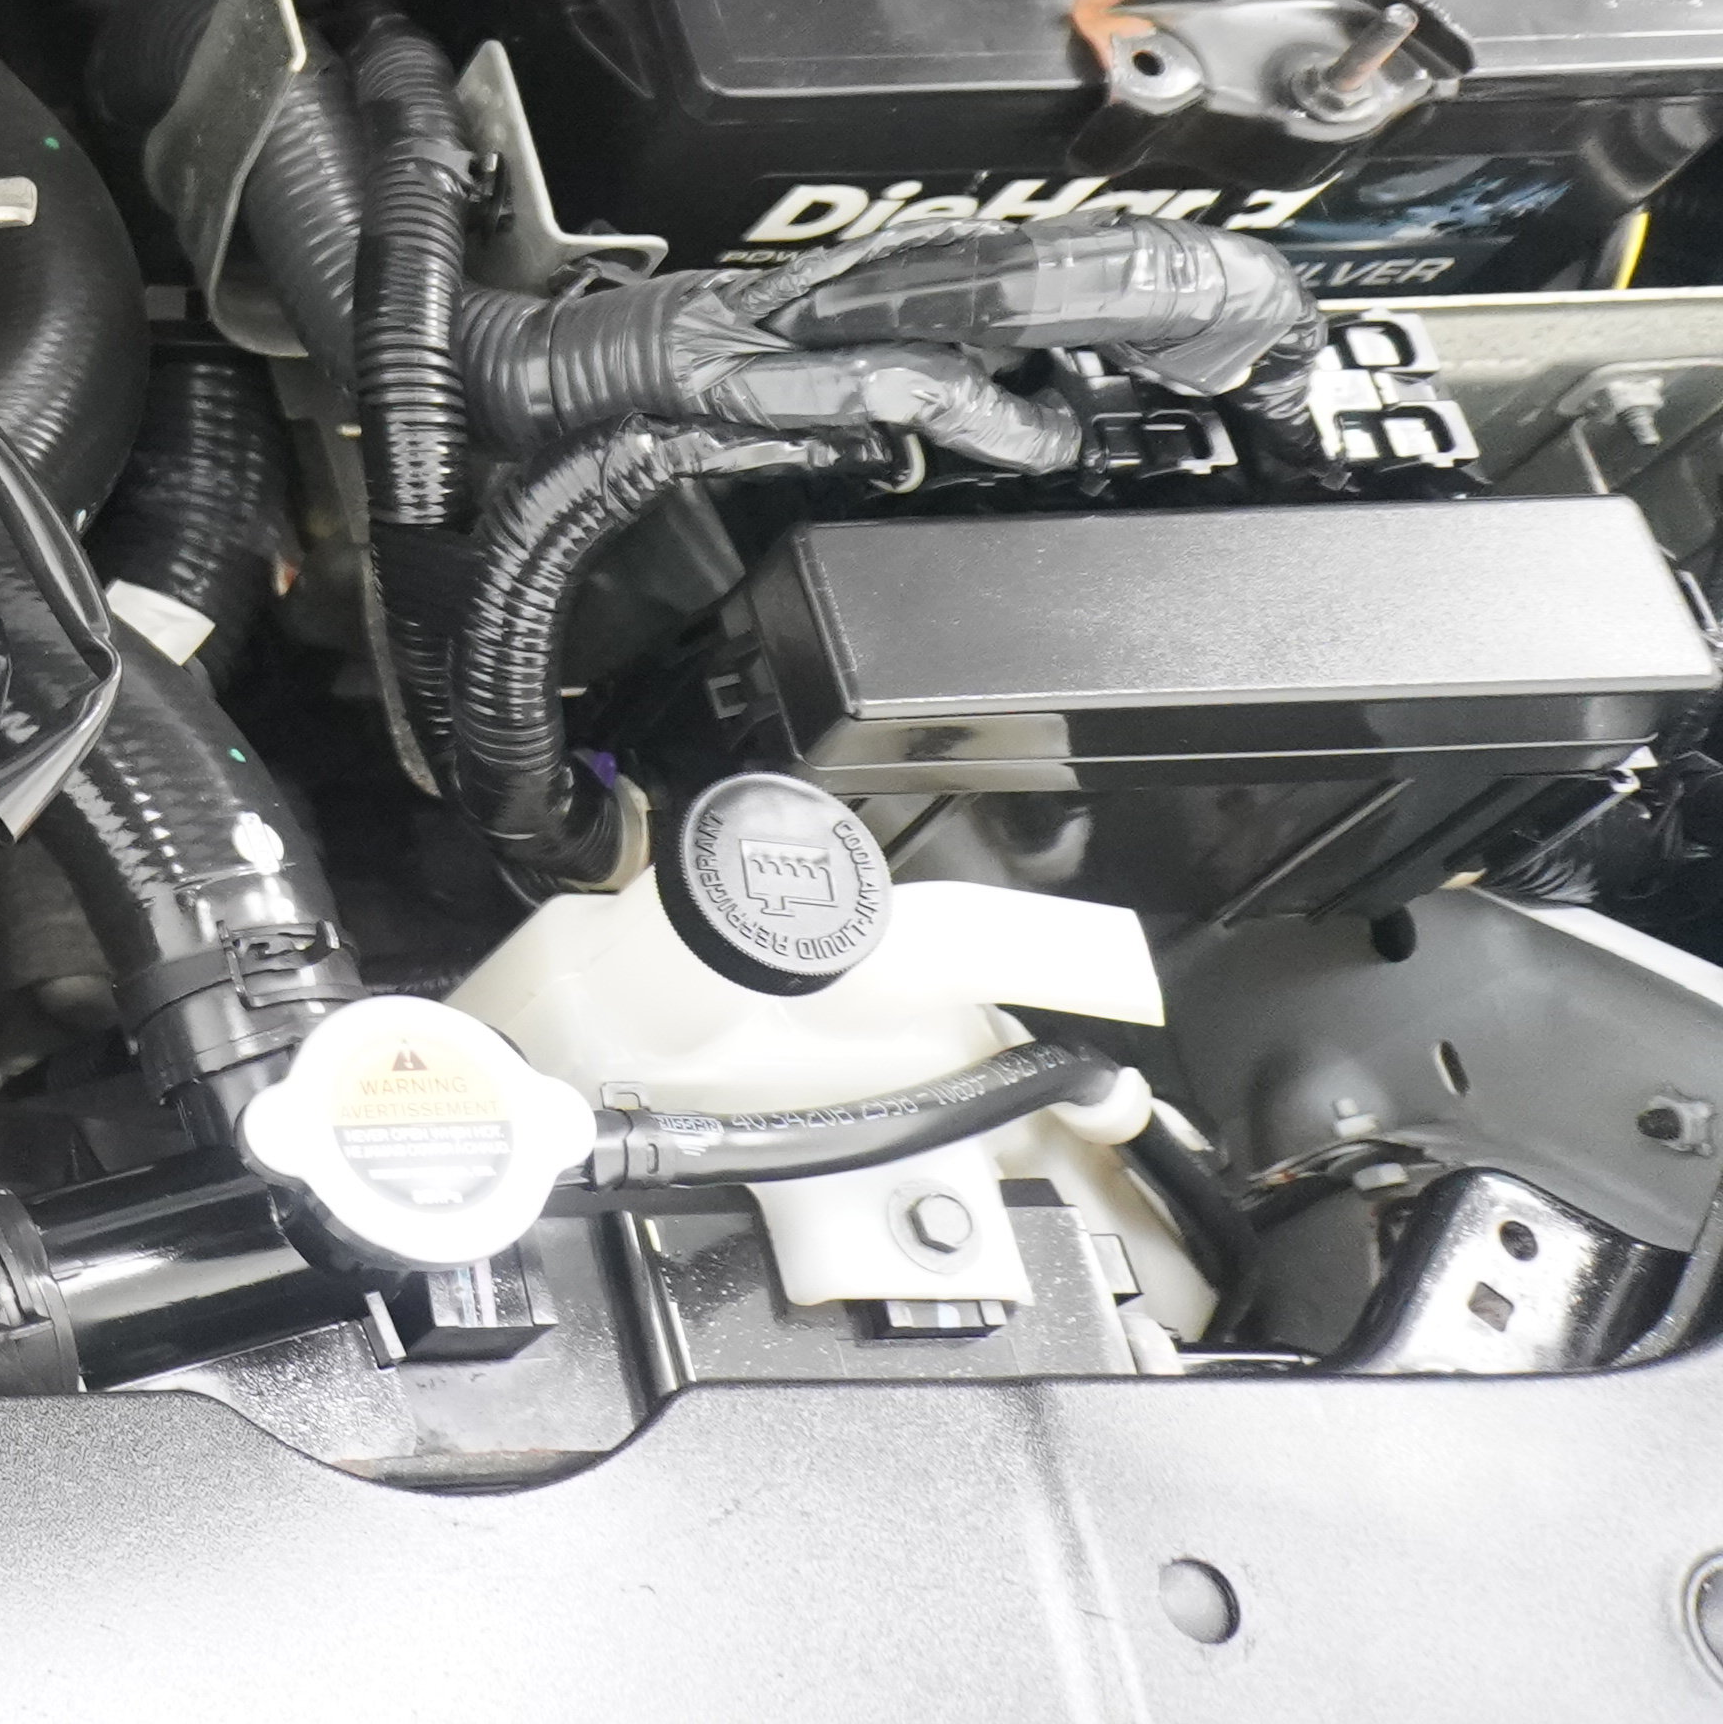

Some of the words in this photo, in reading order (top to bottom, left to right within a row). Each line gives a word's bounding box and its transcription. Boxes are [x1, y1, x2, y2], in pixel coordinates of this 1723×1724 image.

[1294, 256, 1456, 288] LVER
[359, 1075, 469, 1097] WARNING
[340, 1099, 500, 1120] AVERTISSEMENT
[657, 1115, 726, 1134] NISSAN
